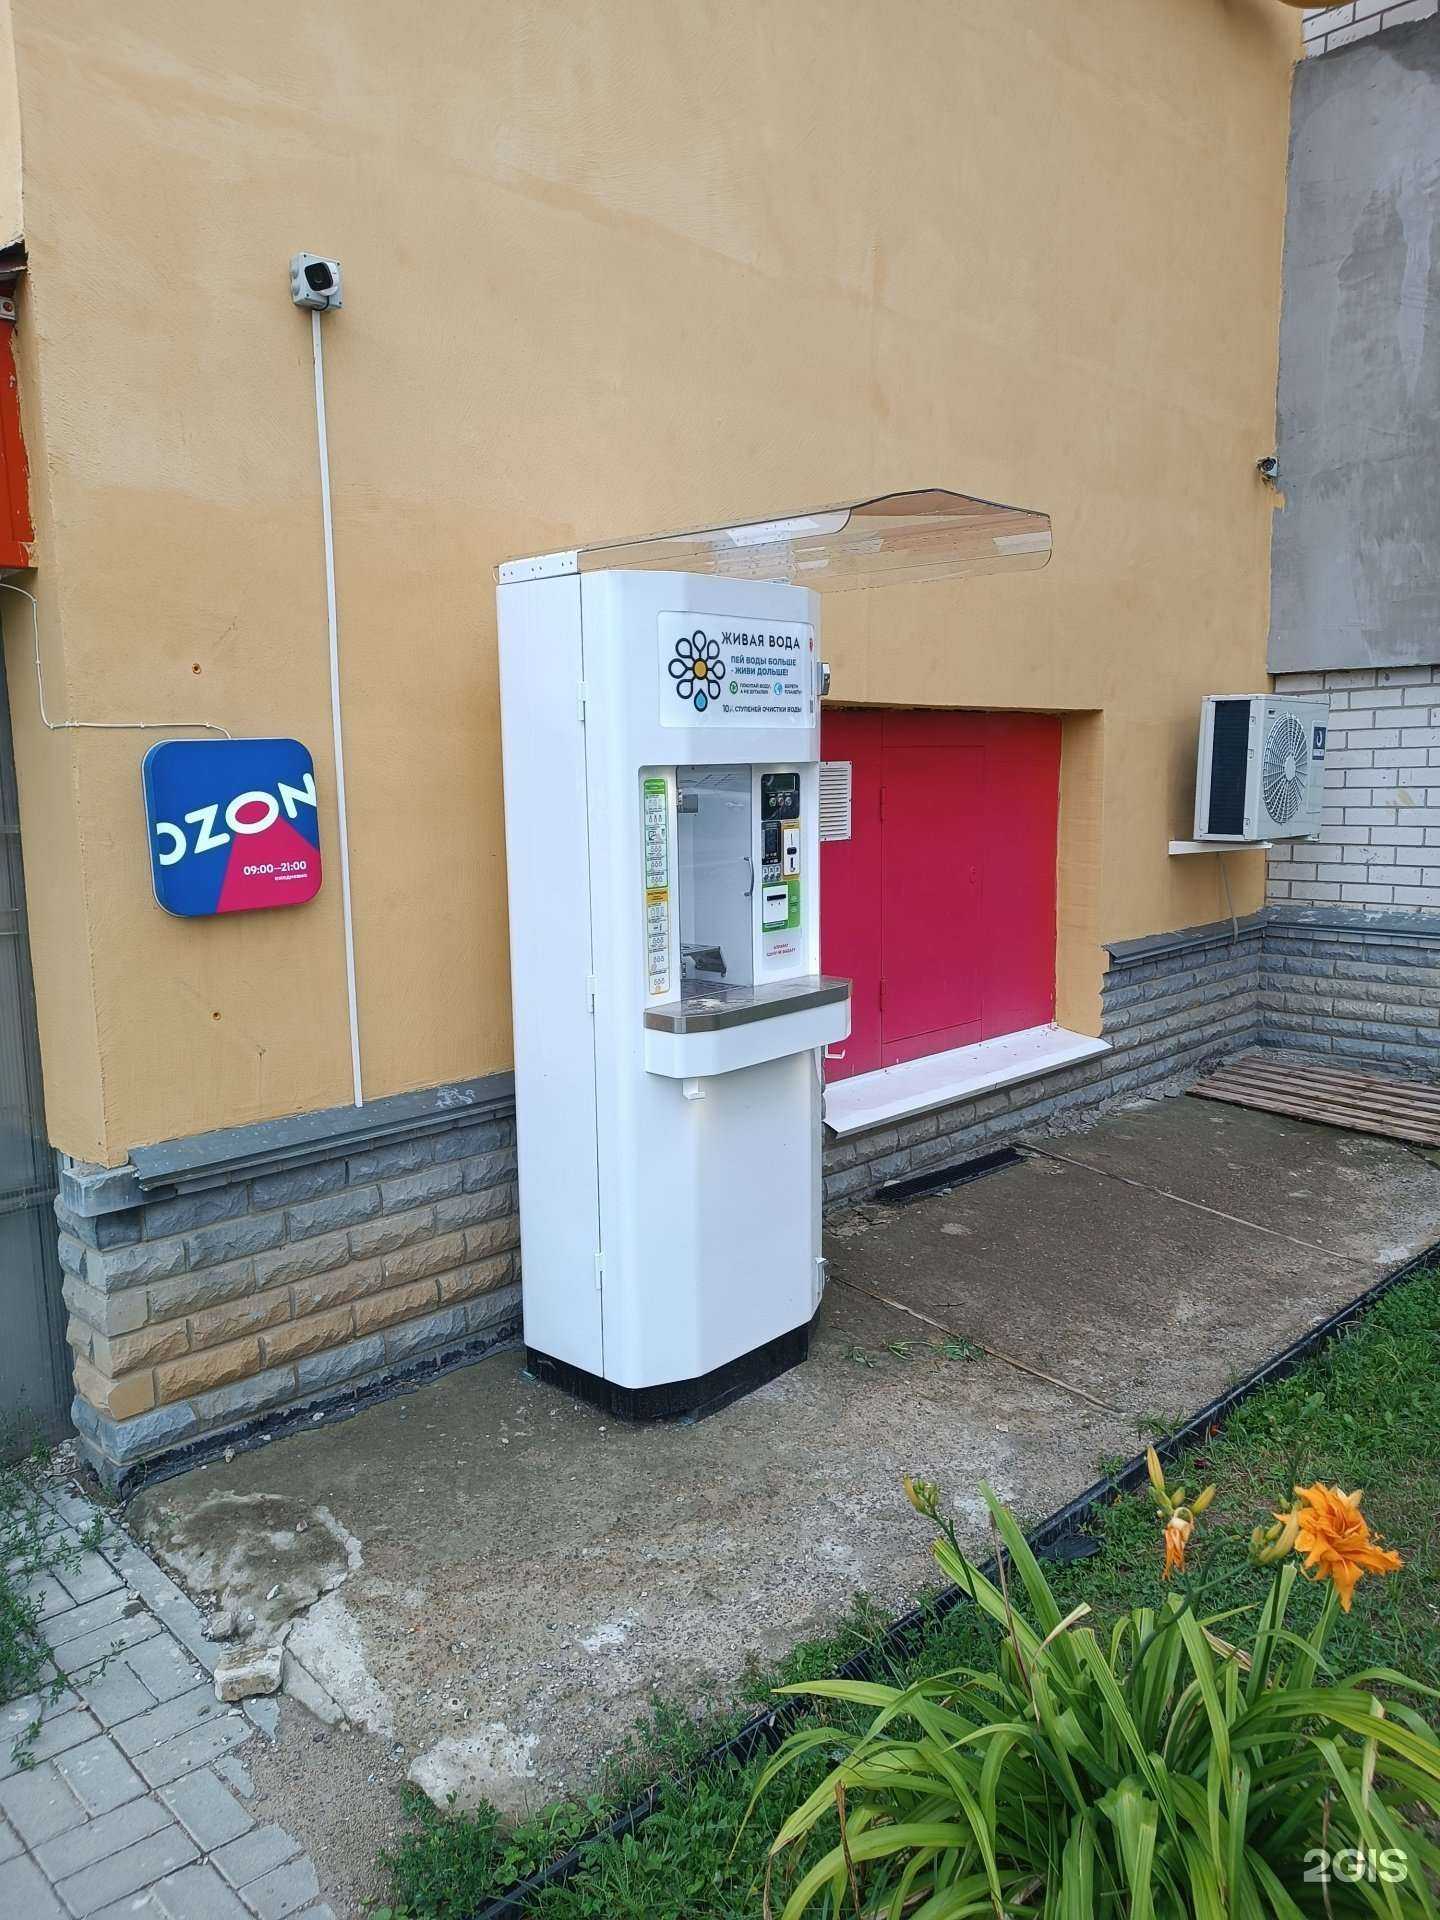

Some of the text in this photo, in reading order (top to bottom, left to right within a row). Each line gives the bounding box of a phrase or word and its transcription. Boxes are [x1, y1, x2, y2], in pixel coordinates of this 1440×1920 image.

[721, 631, 800, 651] ЖИВАЯ ВОДА
[730, 654, 797, 666] ПЕЙ ВОДЫ БОЛЬШЕ
[734, 666, 756, 675] ЖИВИ
[756, 667, 789, 676] ДОЛЬШЕ!
[735, 705, 761, 713] СТУПЕНЕЙ
[156, 772, 317, 866] OZON
